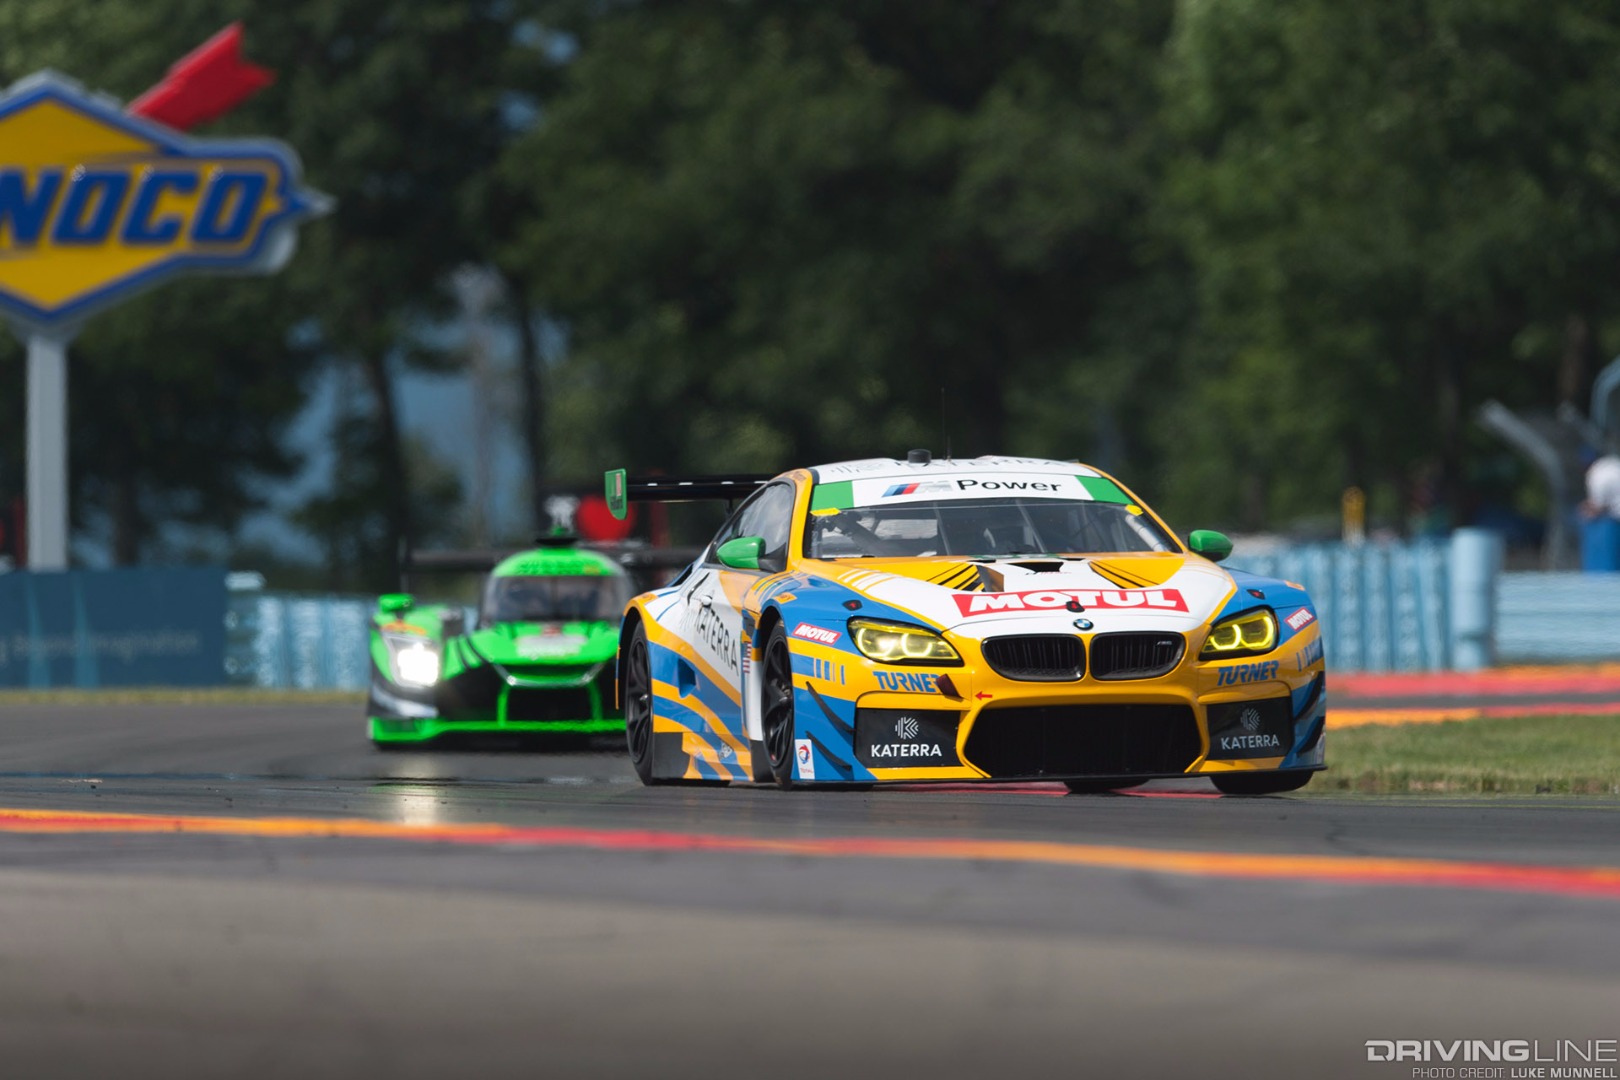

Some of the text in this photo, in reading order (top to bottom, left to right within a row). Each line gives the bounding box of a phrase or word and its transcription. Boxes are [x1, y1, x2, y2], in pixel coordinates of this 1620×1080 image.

[956, 479, 1062, 492] Power
[968, 591, 1179, 612] MOTUL
[794, 624, 837, 643] MOTUL
[1217, 660, 1280, 686] TURNER
[871, 744, 942, 757] KATERRA
[1220, 734, 1280, 750] KATERRA
